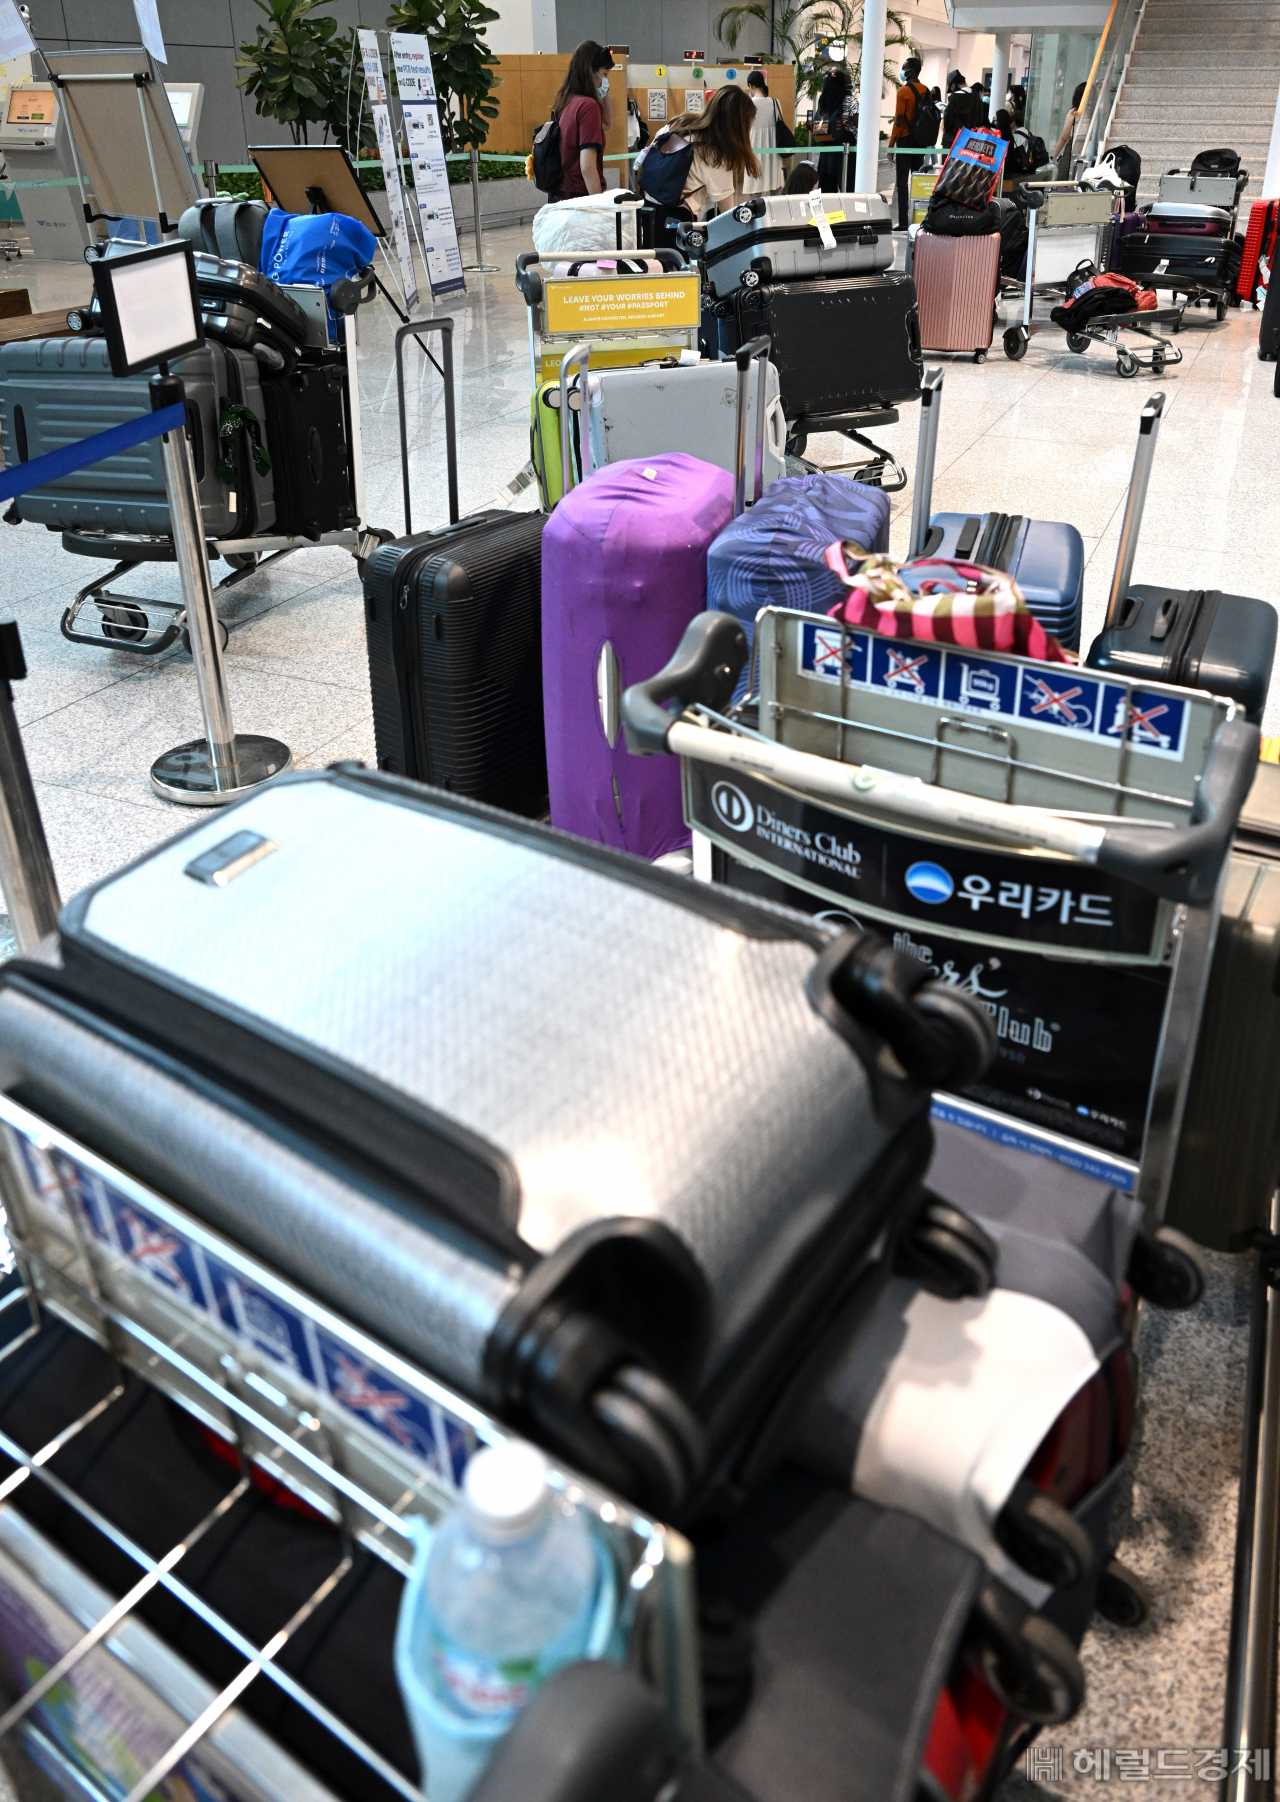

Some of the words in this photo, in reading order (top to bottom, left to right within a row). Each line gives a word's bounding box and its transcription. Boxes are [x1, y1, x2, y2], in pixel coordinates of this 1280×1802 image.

[563, 295, 590, 304] LEAVE
[591, 294, 615, 303] YOUR
[616, 292, 654, 302] WORRIES
[655, 291, 686, 300] BEHIND
[579, 304, 599, 312] #NOT
[601, 303, 626, 311] #YOUR
[627, 301, 669, 310] #PASSPORT
[756, 804, 812, 846] Diners
[815, 832, 861, 865] Club
[756, 825, 862, 879] INTERNATIONAL
[957, 874, 1114, 927] 우리카드
